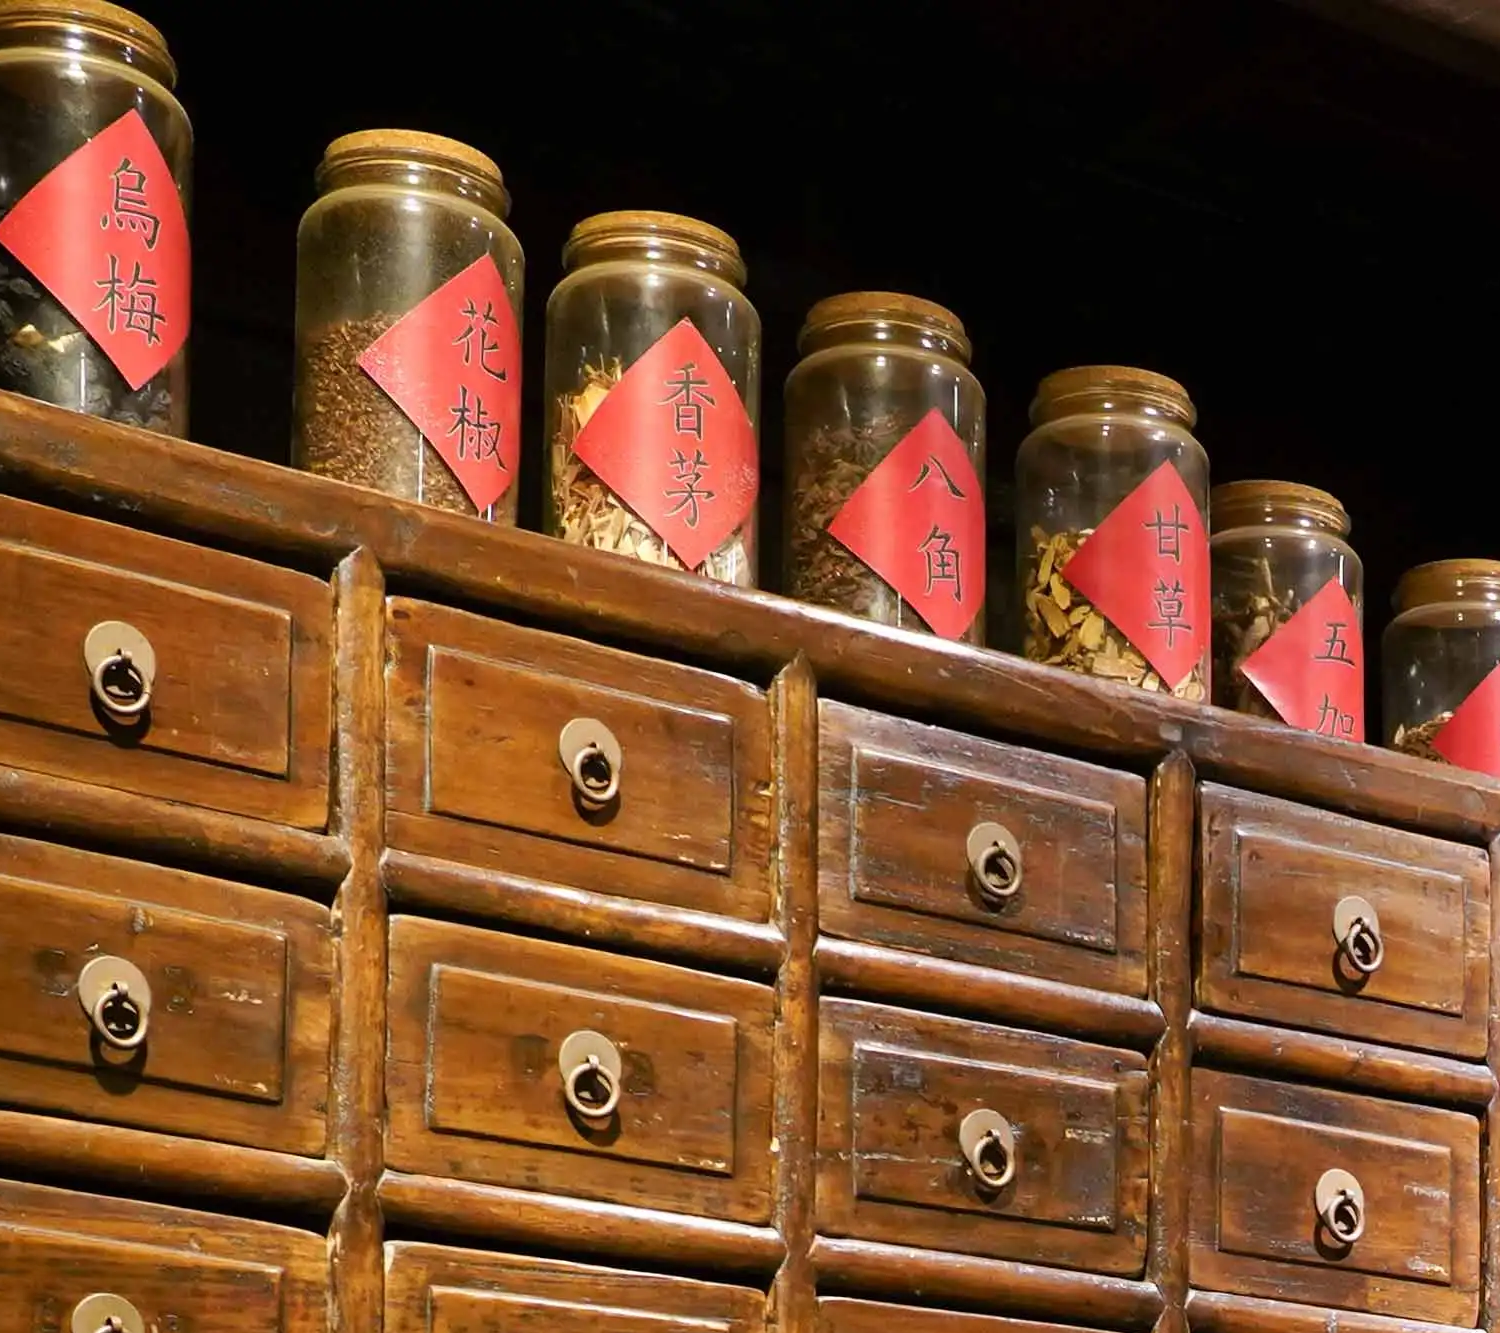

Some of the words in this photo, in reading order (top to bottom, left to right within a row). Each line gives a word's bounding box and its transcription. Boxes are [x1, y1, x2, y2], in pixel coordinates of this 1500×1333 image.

[93, 157, 168, 347] 烏梅
[447, 297, 510, 473] 花椒
[656, 361, 717, 529] 香茅
[909, 453, 966, 606] 八角
[1144, 504, 1192, 648] 甘草
